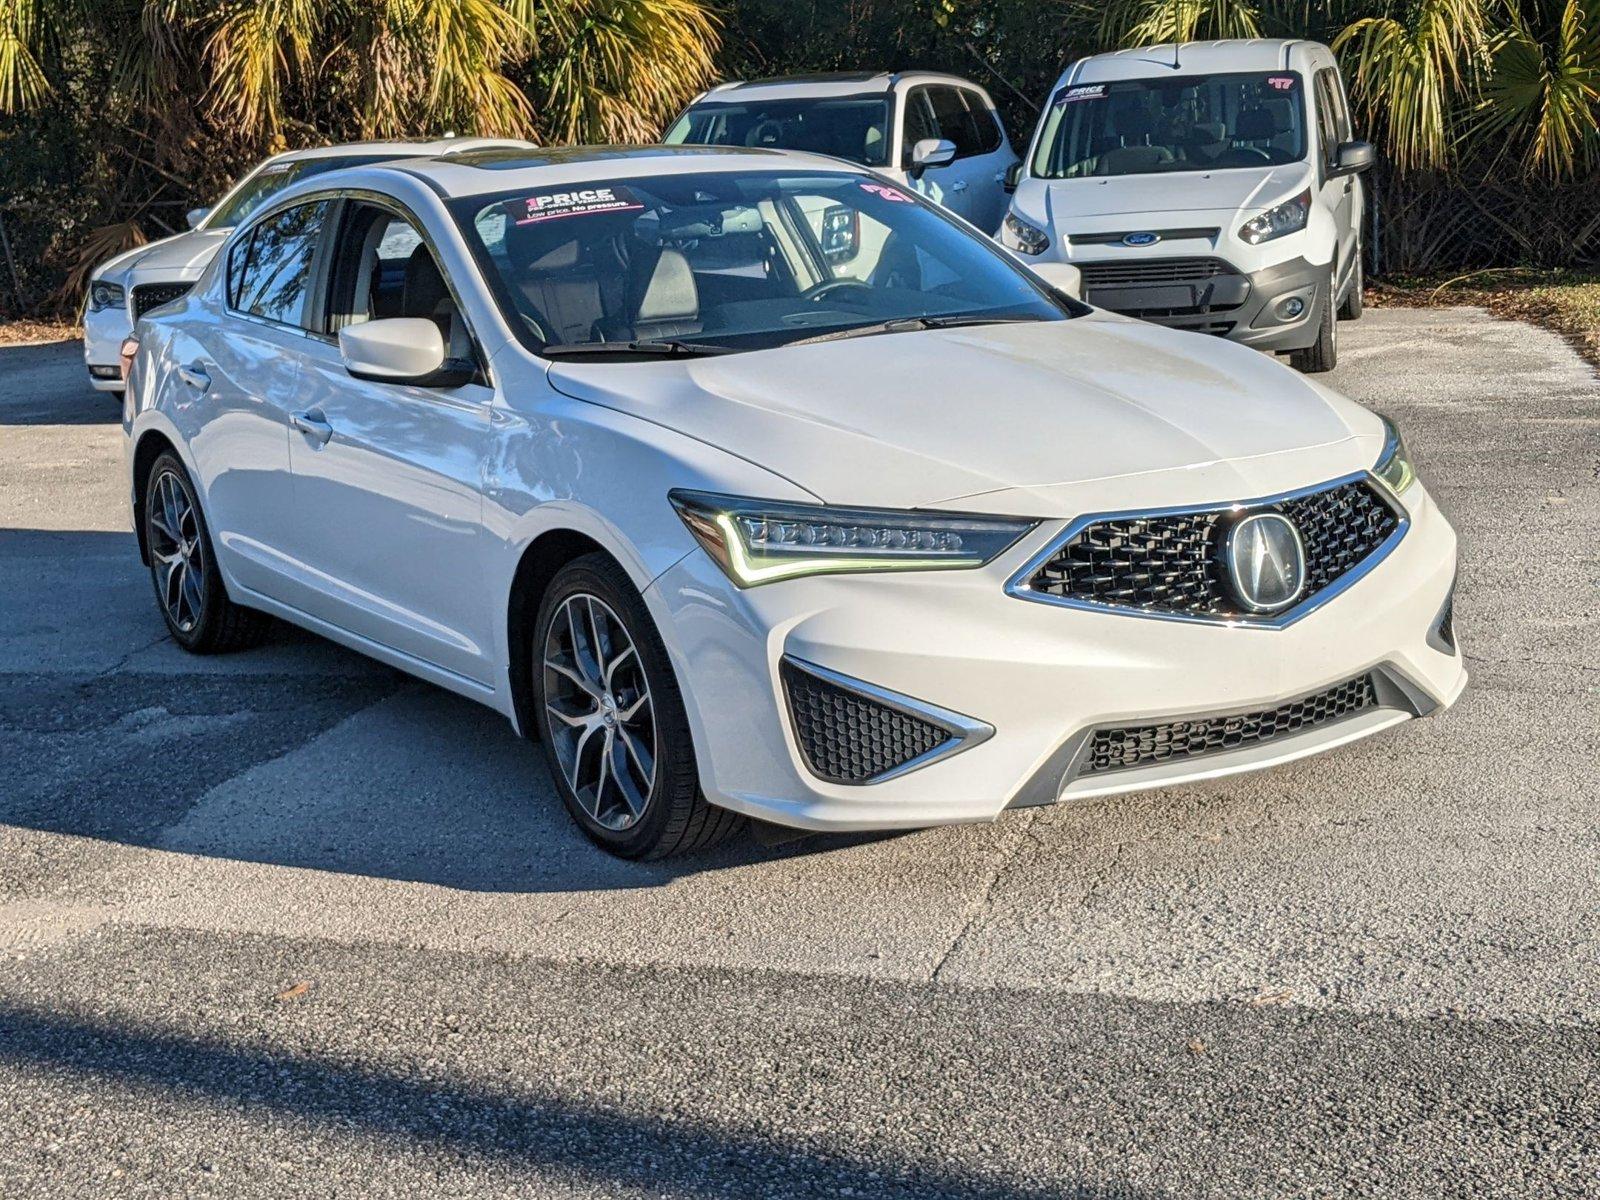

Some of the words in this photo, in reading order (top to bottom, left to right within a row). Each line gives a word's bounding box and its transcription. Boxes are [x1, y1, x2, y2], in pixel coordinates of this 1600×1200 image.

[527, 210, 546, 220] Low
[547, 207, 570, 216] price.
[587, 201, 629, 212] pressure.
